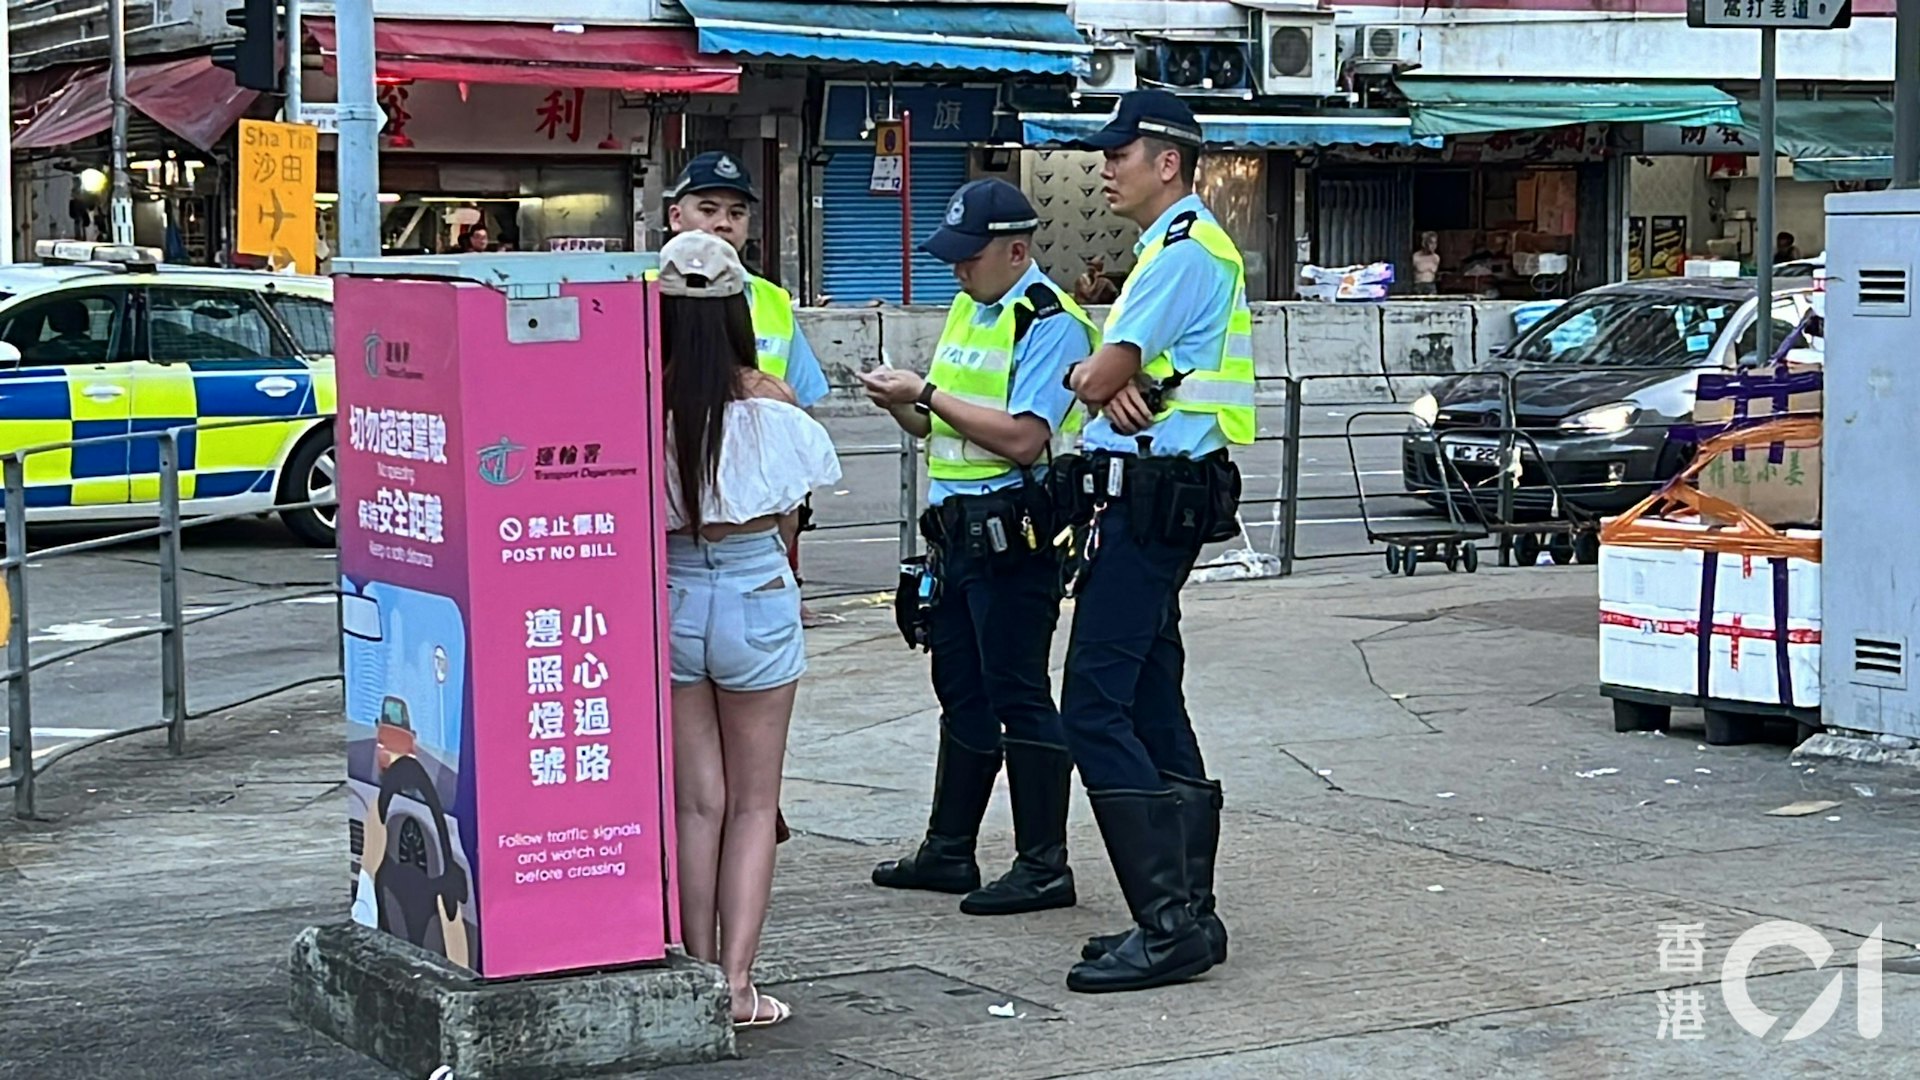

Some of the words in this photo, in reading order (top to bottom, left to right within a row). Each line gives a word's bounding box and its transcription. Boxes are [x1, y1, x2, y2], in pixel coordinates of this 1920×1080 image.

[245, 126, 280, 147] Sha
[287, 128, 314, 150] Tin
[349, 404, 448, 465] 切勿超速駕駛
[502, 547, 546, 563] POST
[550, 545, 575, 560] NO
[580, 543, 617, 558] BILL
[525, 609, 567, 787] 遵照燈號
[571, 606, 612, 782] 小心過路
[498, 834, 542, 848] Follow
[547, 828, 589, 842] traffic
[593, 823, 641, 841] signals
[518, 850, 547, 865] and
[551, 846, 594, 861] watch
[600, 842, 622, 856] out
[515, 869, 562, 884] before
[567, 862, 625, 879] crossing
